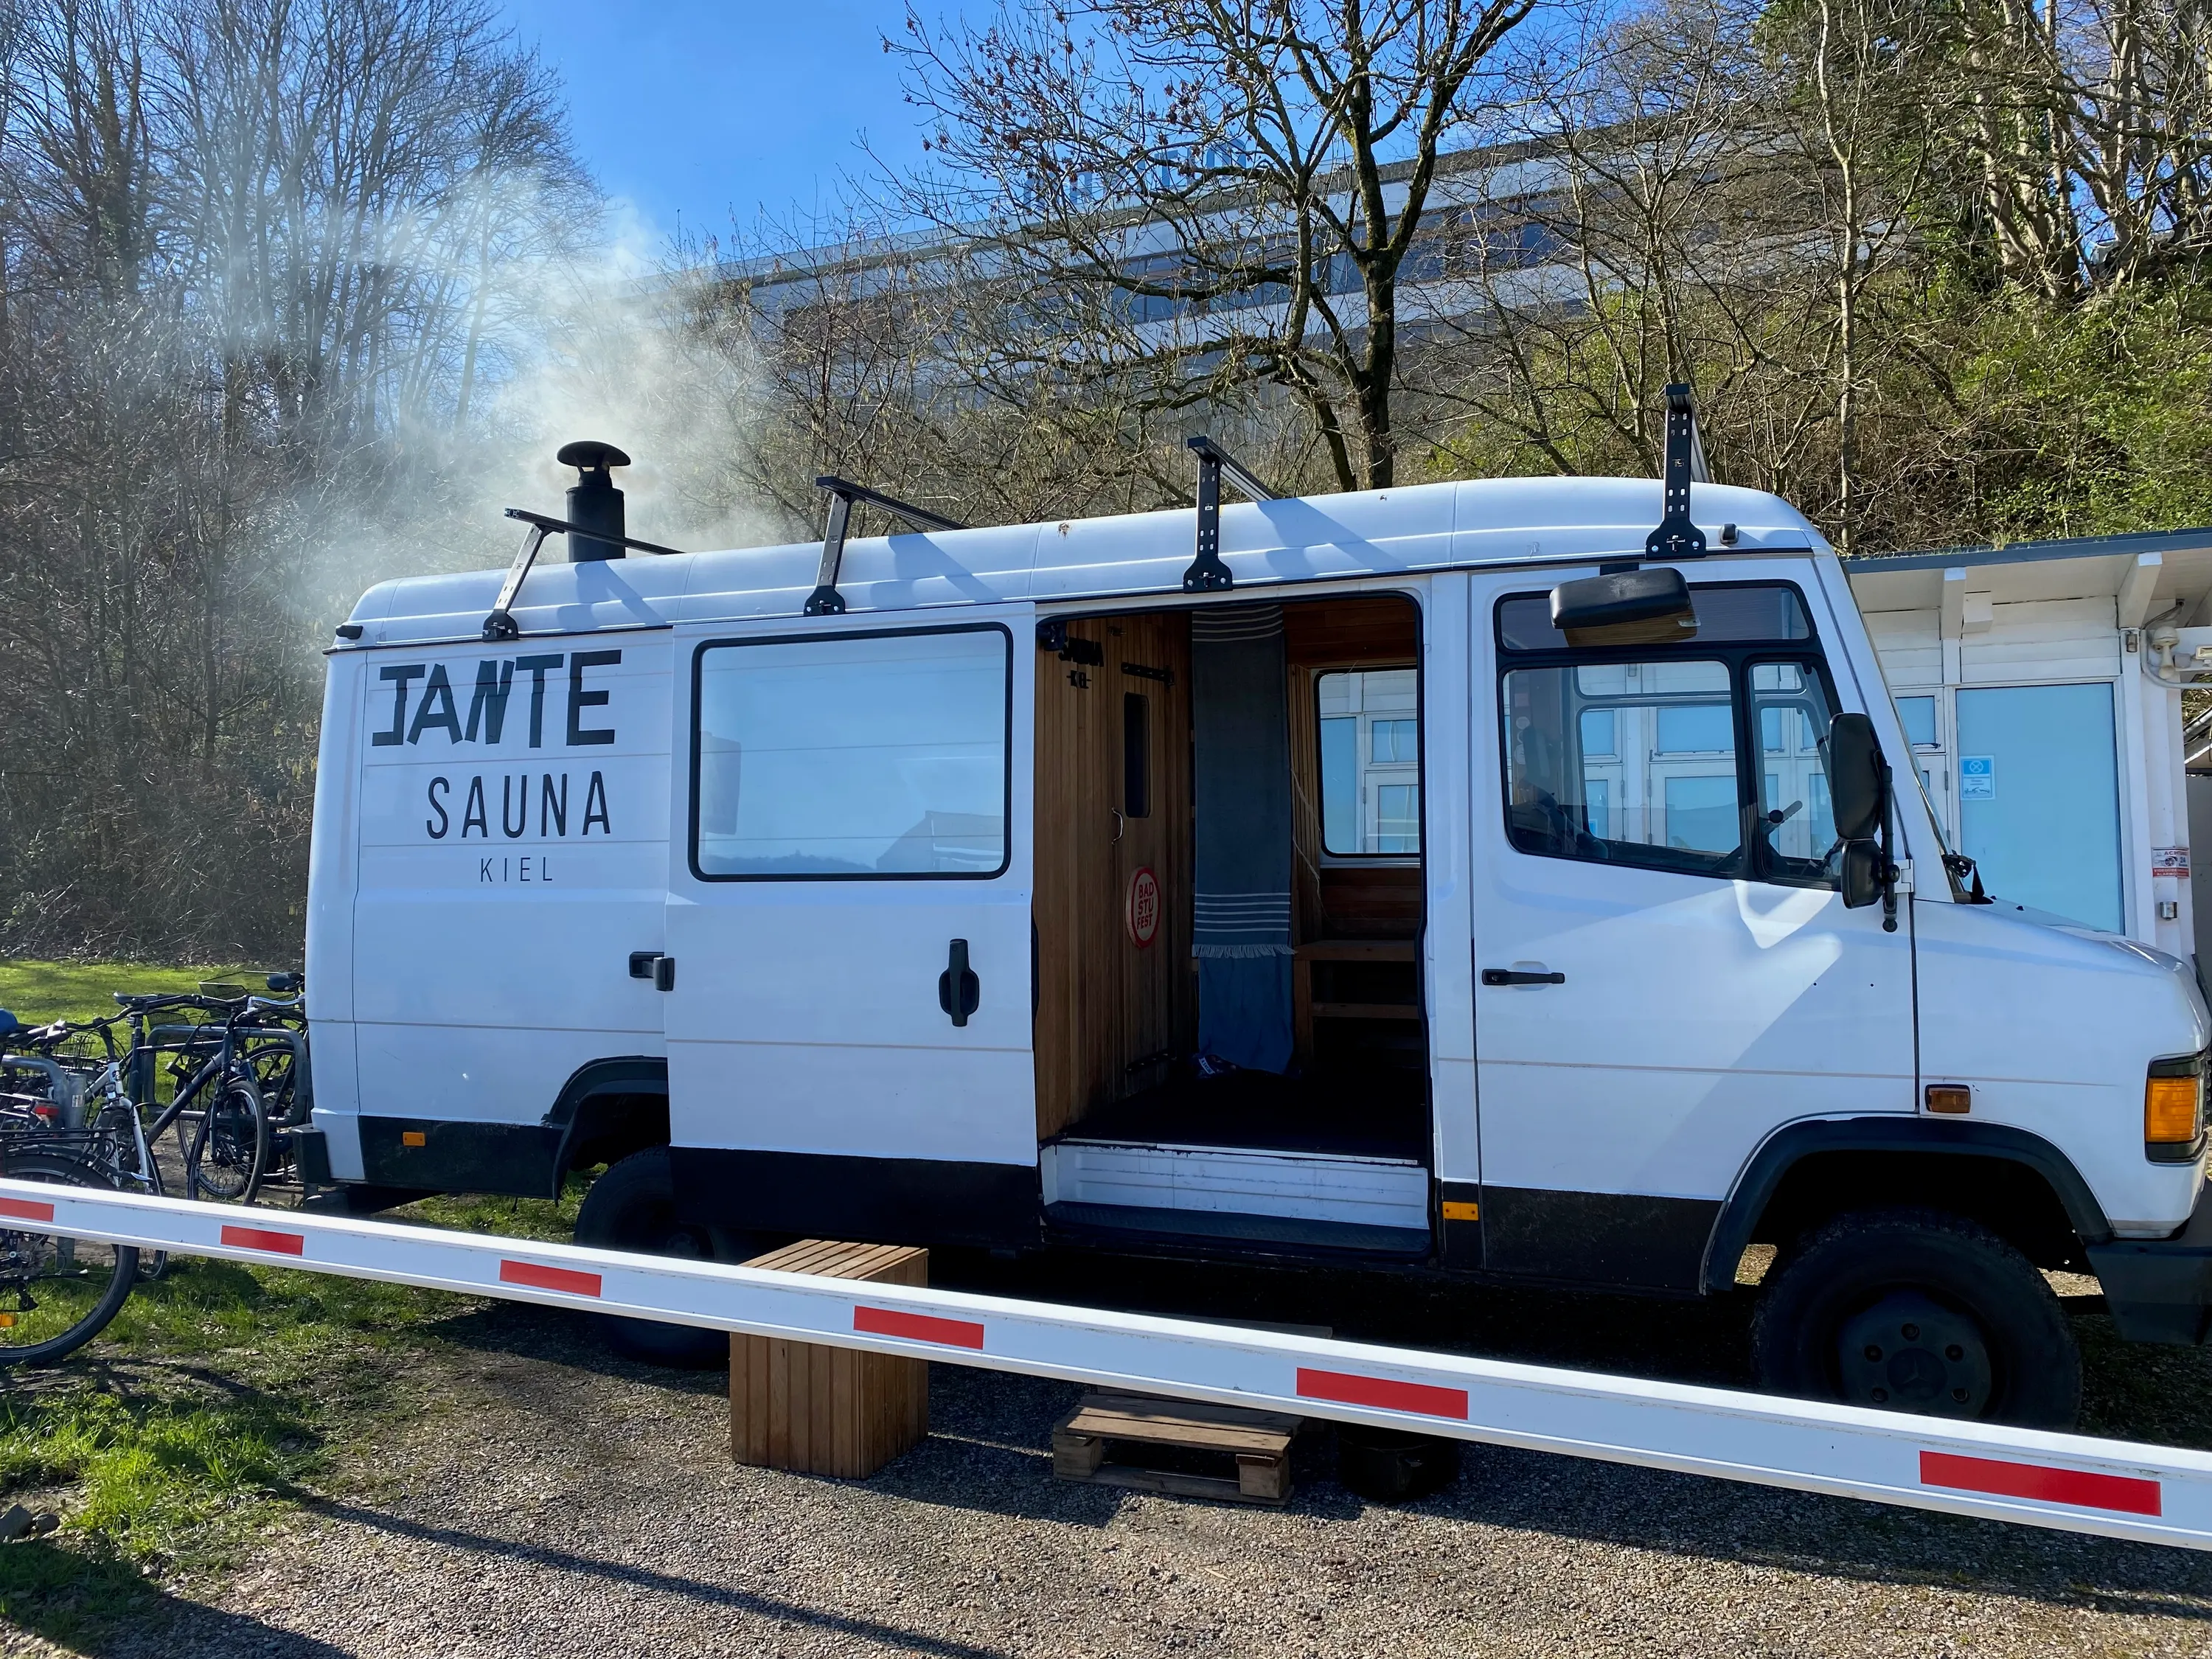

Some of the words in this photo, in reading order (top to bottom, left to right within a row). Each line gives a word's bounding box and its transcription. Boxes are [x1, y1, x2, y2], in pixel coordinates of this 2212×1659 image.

[426, 771, 611, 839] SAUNA
[480, 857, 552, 882] KIEL
[1138, 882, 1154, 899] BAD
[1138, 897, 1154, 915] STU
[1136, 914, 1152, 930] FEST
